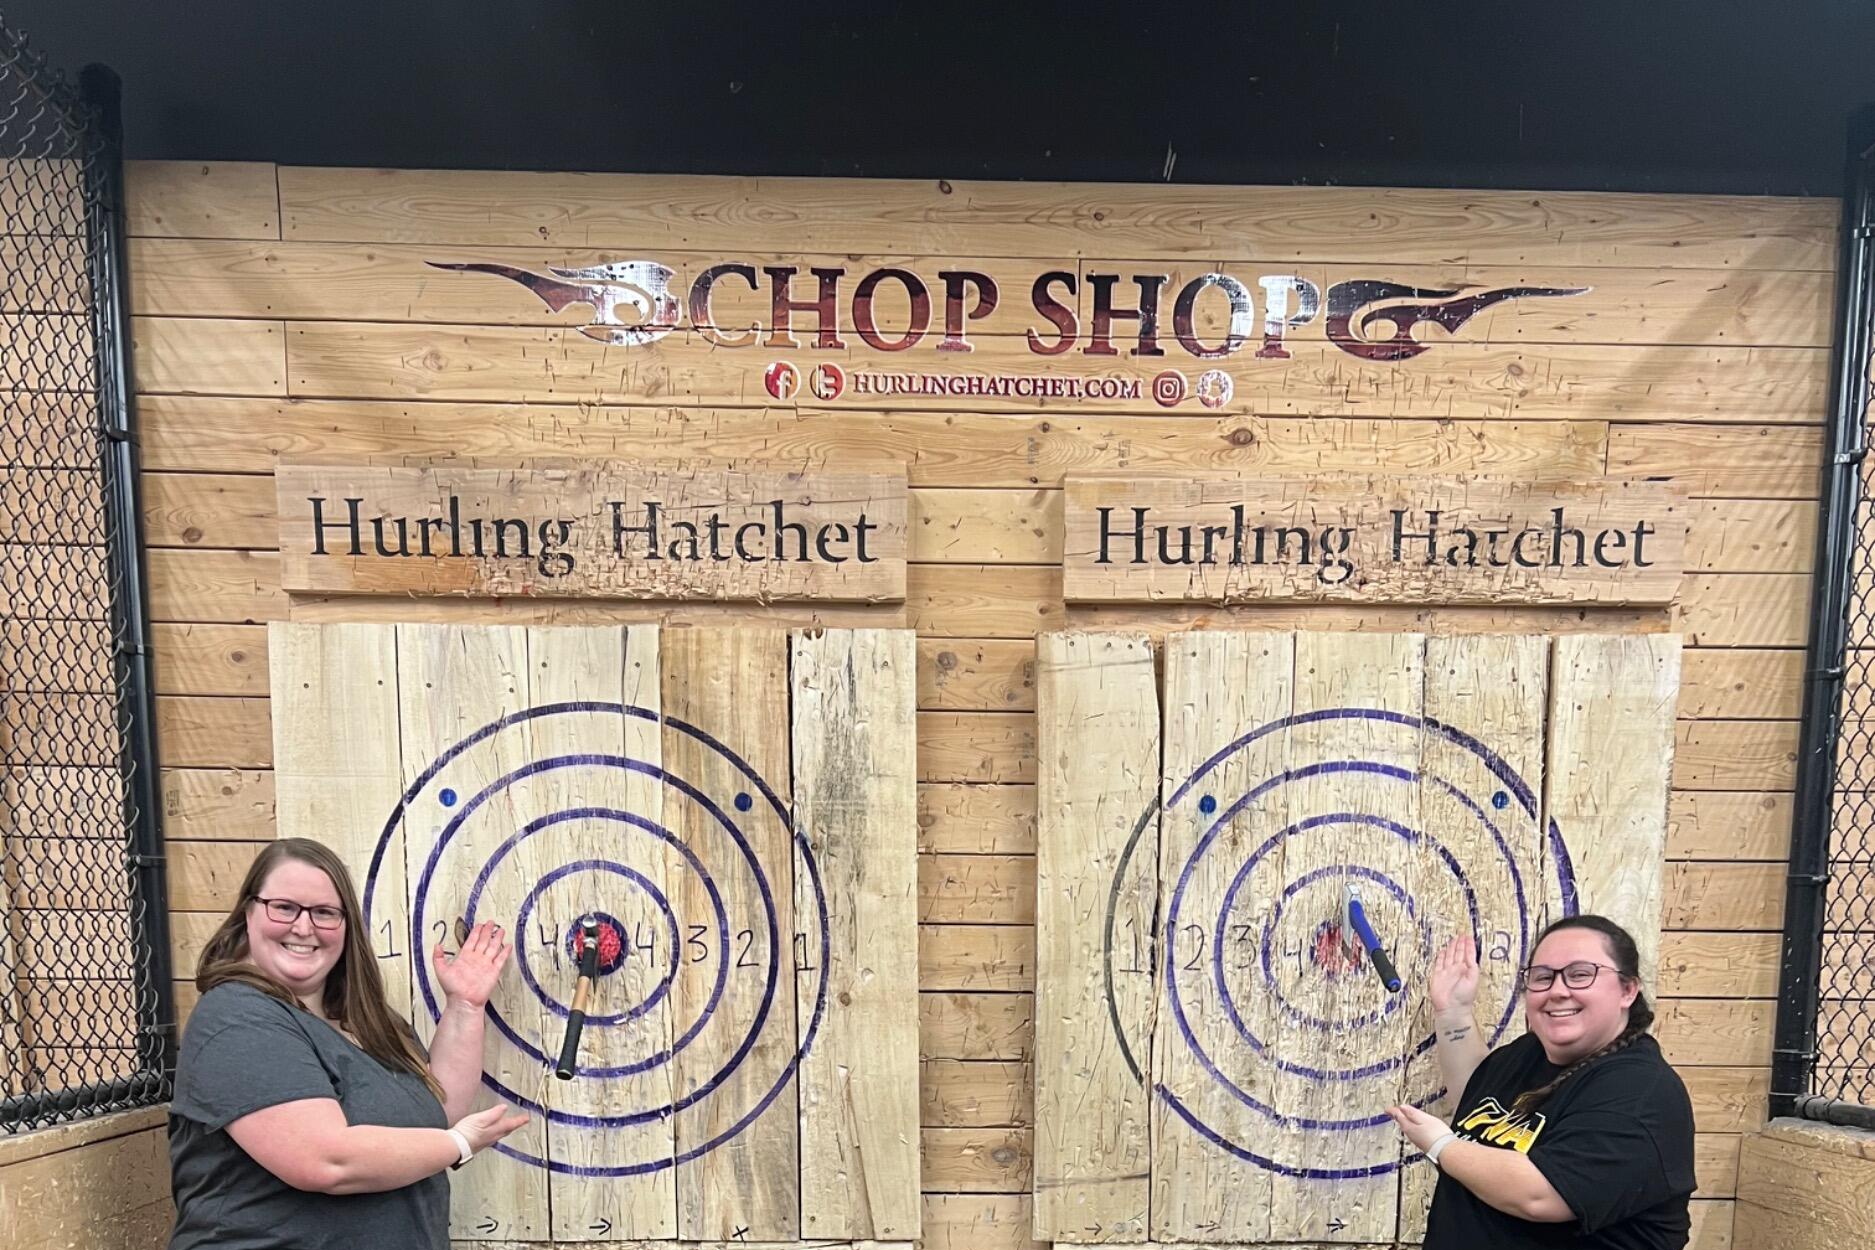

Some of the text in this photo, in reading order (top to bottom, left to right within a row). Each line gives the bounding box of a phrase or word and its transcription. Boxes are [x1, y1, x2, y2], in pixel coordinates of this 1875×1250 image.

[687, 262, 1322, 360] CHOP SHOP
[852, 371, 1143, 400] HURLINGHATCHET.COM
[307, 496, 879, 578] Hurling Hatchet
[1094, 504, 1655, 585] Hurling Hatchet
[377, 919, 402, 959] 1
[540, 923, 560, 971] 4
[635, 921, 656, 968] 4
[687, 924, 709, 963] 3
[735, 929, 760, 969] 2
[795, 932, 816, 972] 1
[1119, 917, 1145, 974] 1
[1182, 924, 1205, 972] 2
[1232, 924, 1257, 969] 3
[1489, 930, 1511, 963] 2
